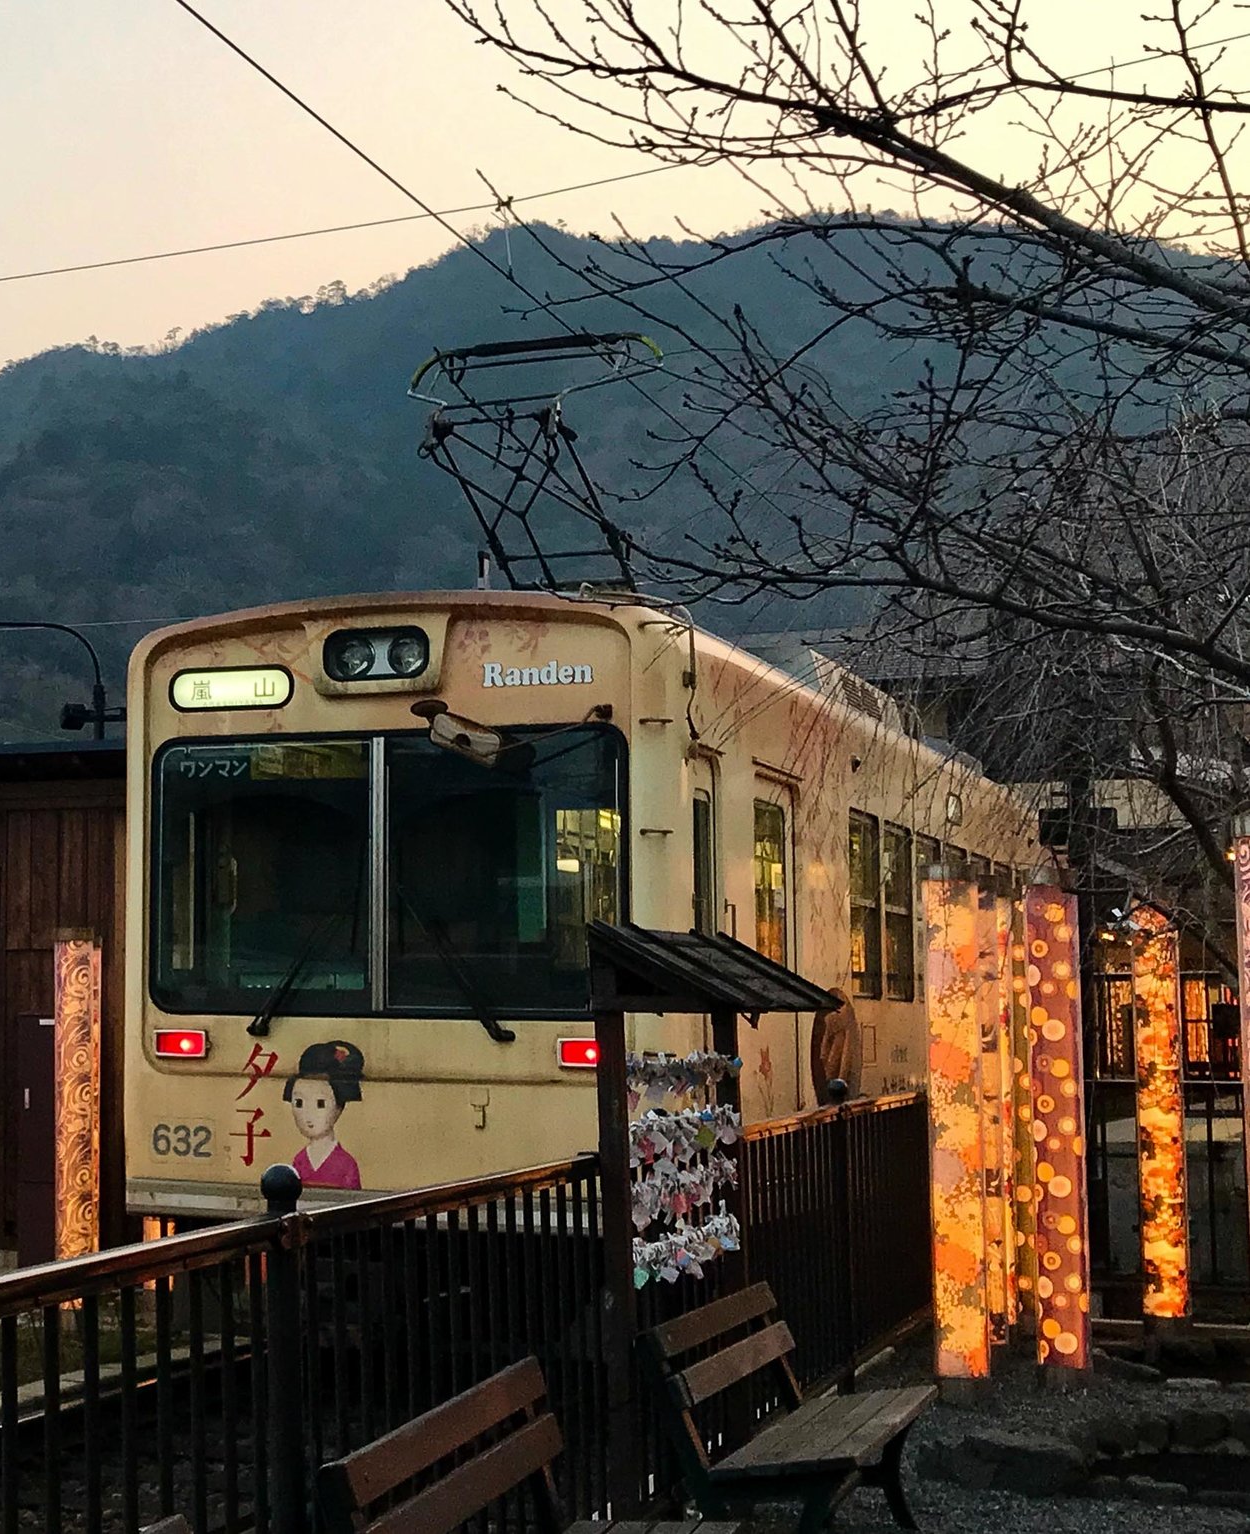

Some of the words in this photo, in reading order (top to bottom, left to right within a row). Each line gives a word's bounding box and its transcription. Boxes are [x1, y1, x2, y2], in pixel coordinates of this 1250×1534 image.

[482, 659, 593, 688] Randen
[191, 677, 275, 700] 嵐山
[180, 761, 248, 778] ワンマン
[229, 1042, 279, 1167] 夕子
[152, 1124, 213, 1158] 632
